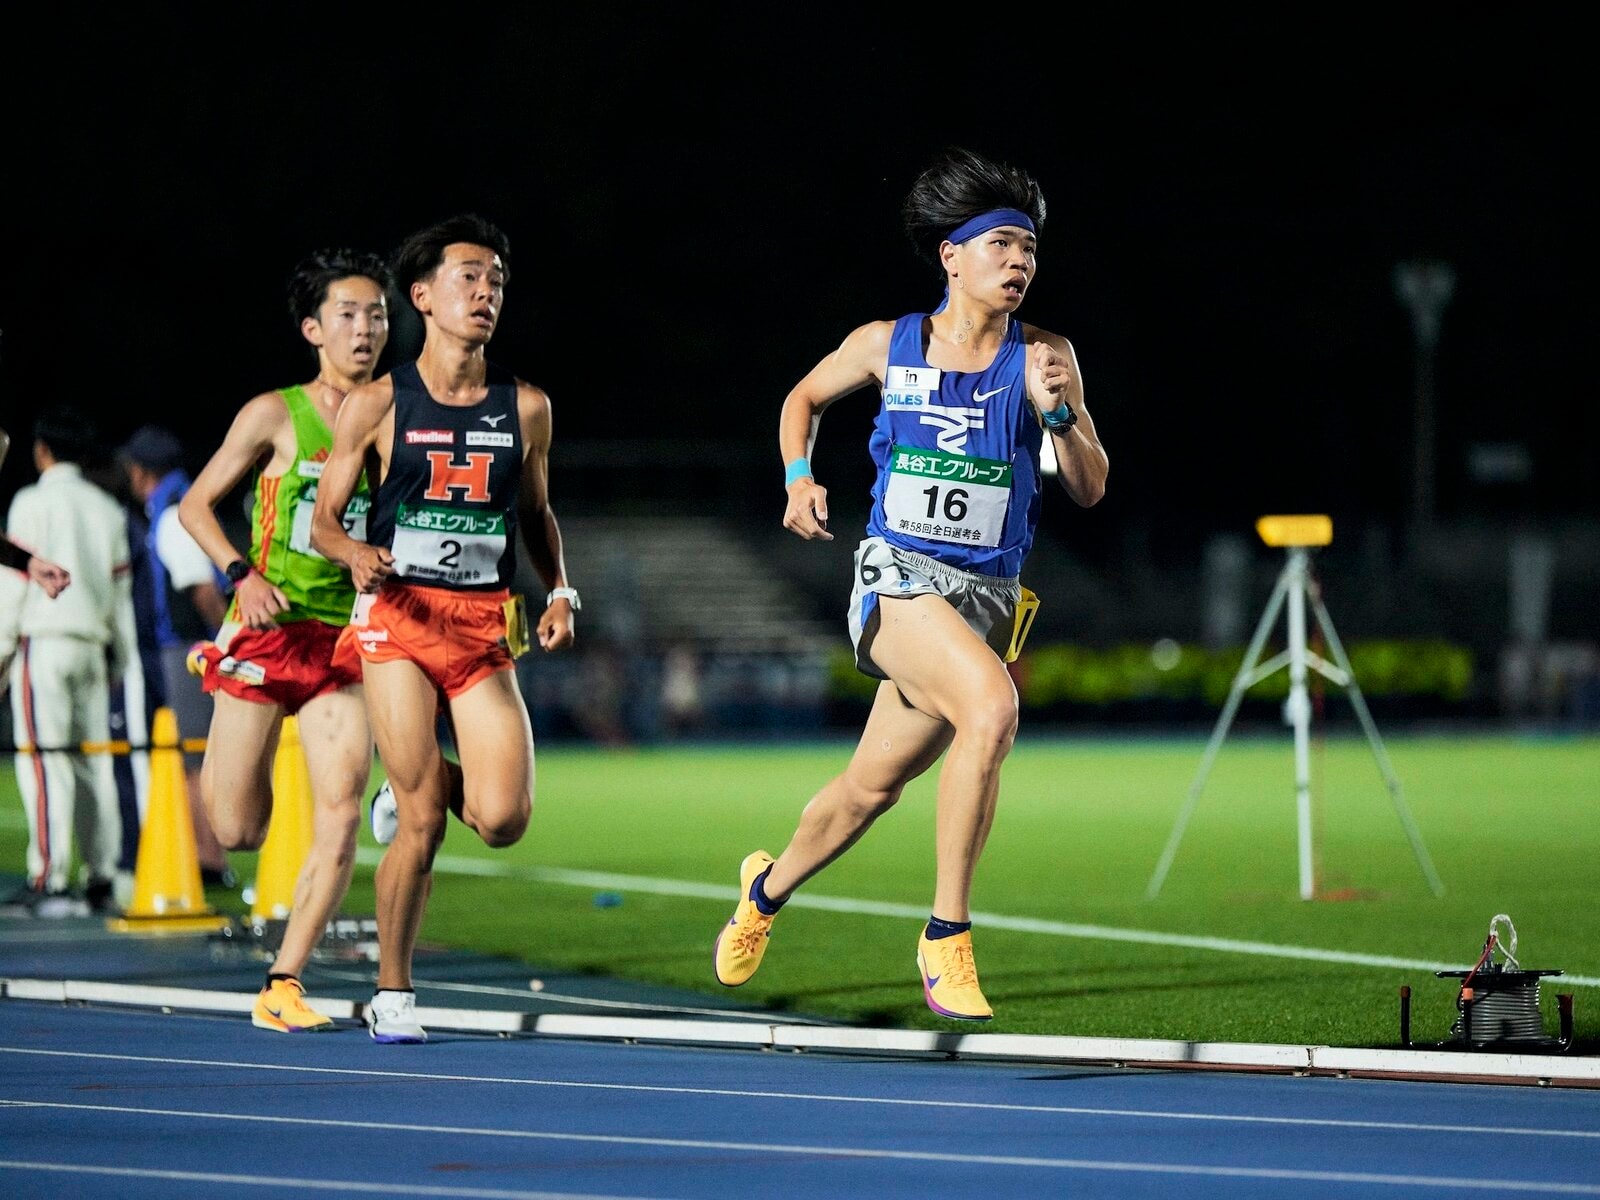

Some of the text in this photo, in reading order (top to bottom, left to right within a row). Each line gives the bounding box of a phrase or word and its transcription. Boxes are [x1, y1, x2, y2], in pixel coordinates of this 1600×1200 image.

[905, 370, 918, 383] in
[886, 394, 924, 406] OILES
[423, 450, 495, 503] H
[895, 452, 1008, 483] 長谷工グループ
[922, 485, 969, 522] 16
[898, 518, 982, 541] 第58回全日選考会
[438, 540, 462, 569] 2
